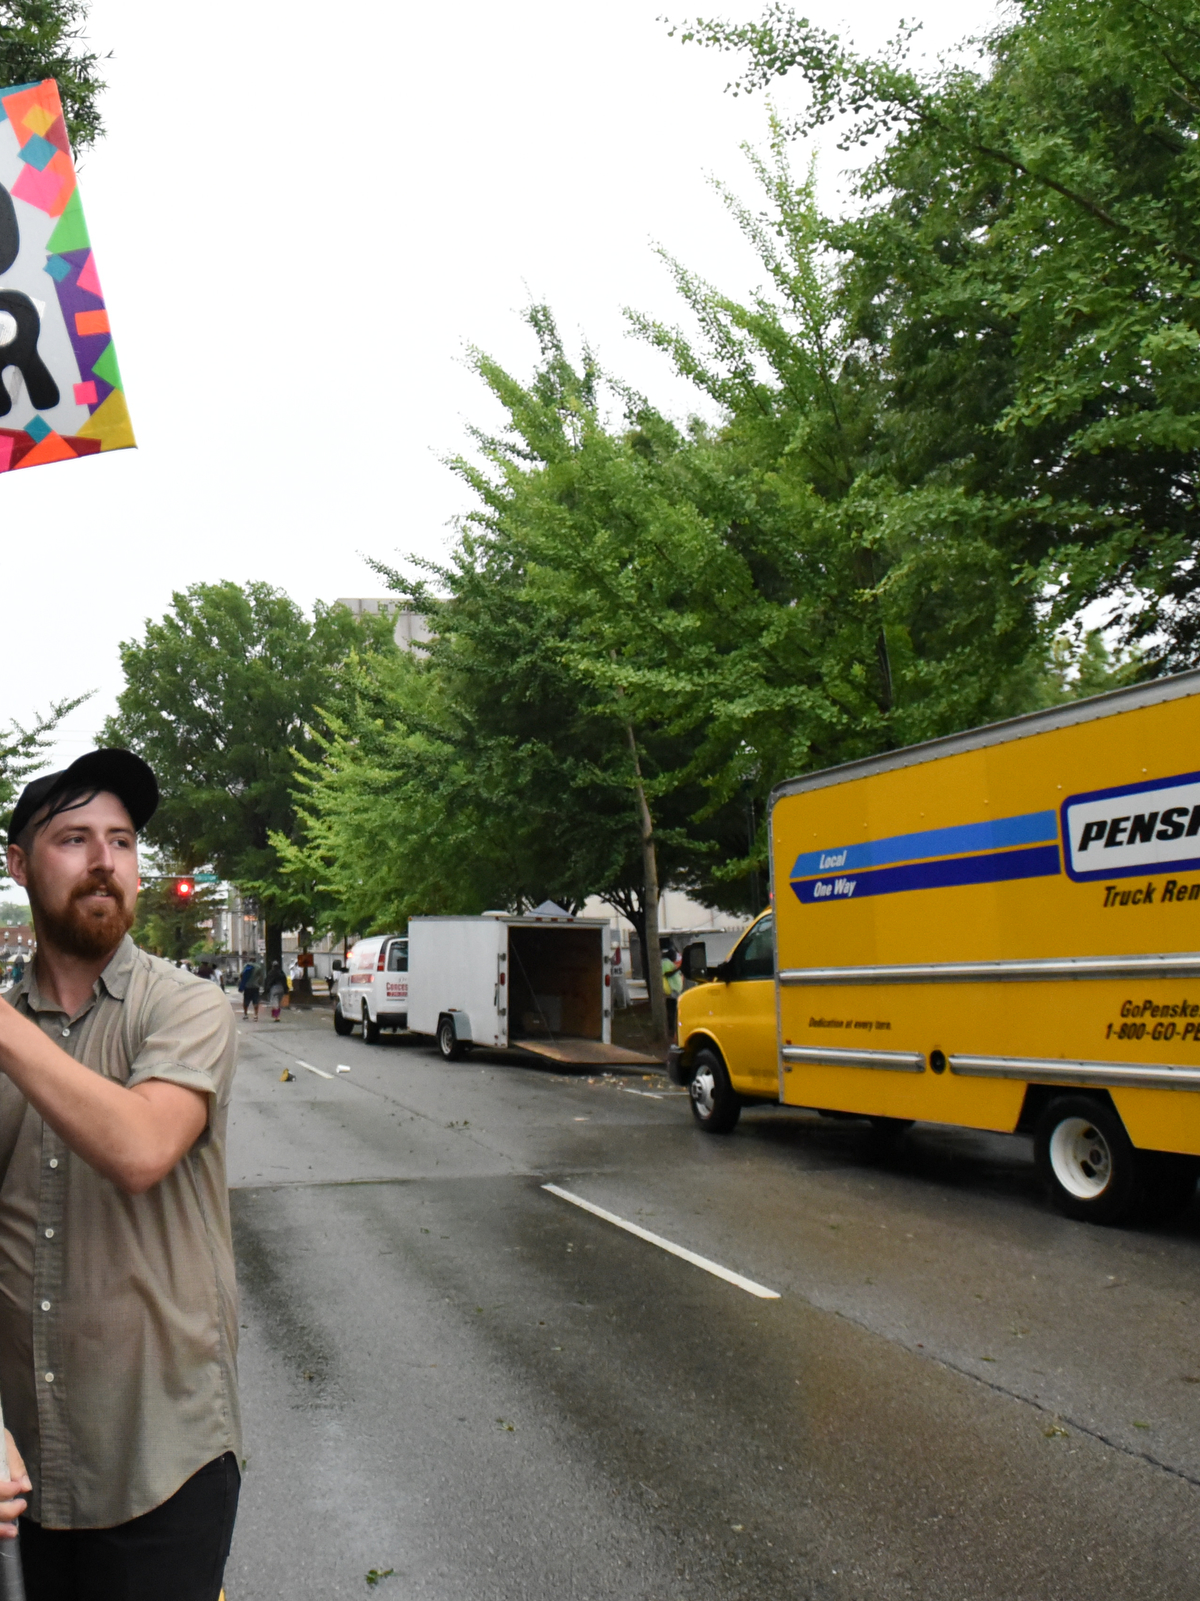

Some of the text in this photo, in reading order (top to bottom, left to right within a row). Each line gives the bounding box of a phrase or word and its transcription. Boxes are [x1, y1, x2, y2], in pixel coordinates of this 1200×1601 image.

[819, 849, 848, 869] Local
[813, 877, 857, 898] One Way
[1103, 881, 1156, 908] Truck
